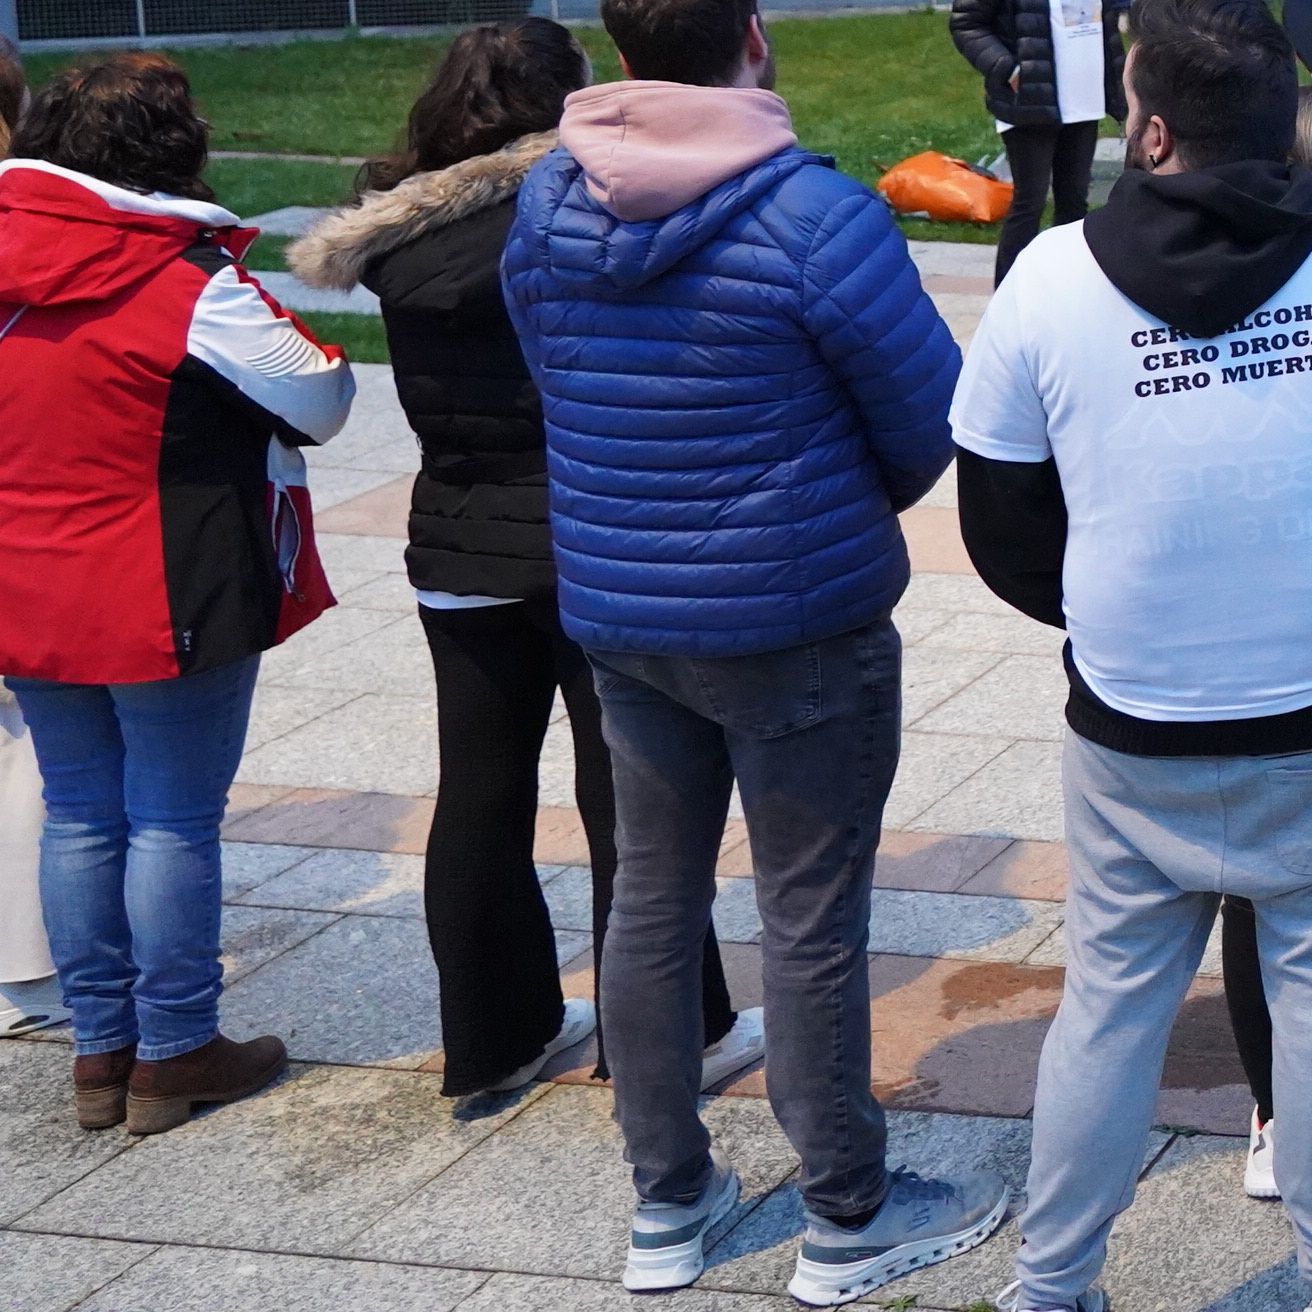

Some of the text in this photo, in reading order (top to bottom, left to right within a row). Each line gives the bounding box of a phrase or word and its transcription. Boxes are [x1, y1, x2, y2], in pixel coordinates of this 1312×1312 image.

[1131, 324, 1201, 348] CER
[1142, 345, 1220, 371] CERO
[1134, 371, 1211, 398] CERO
